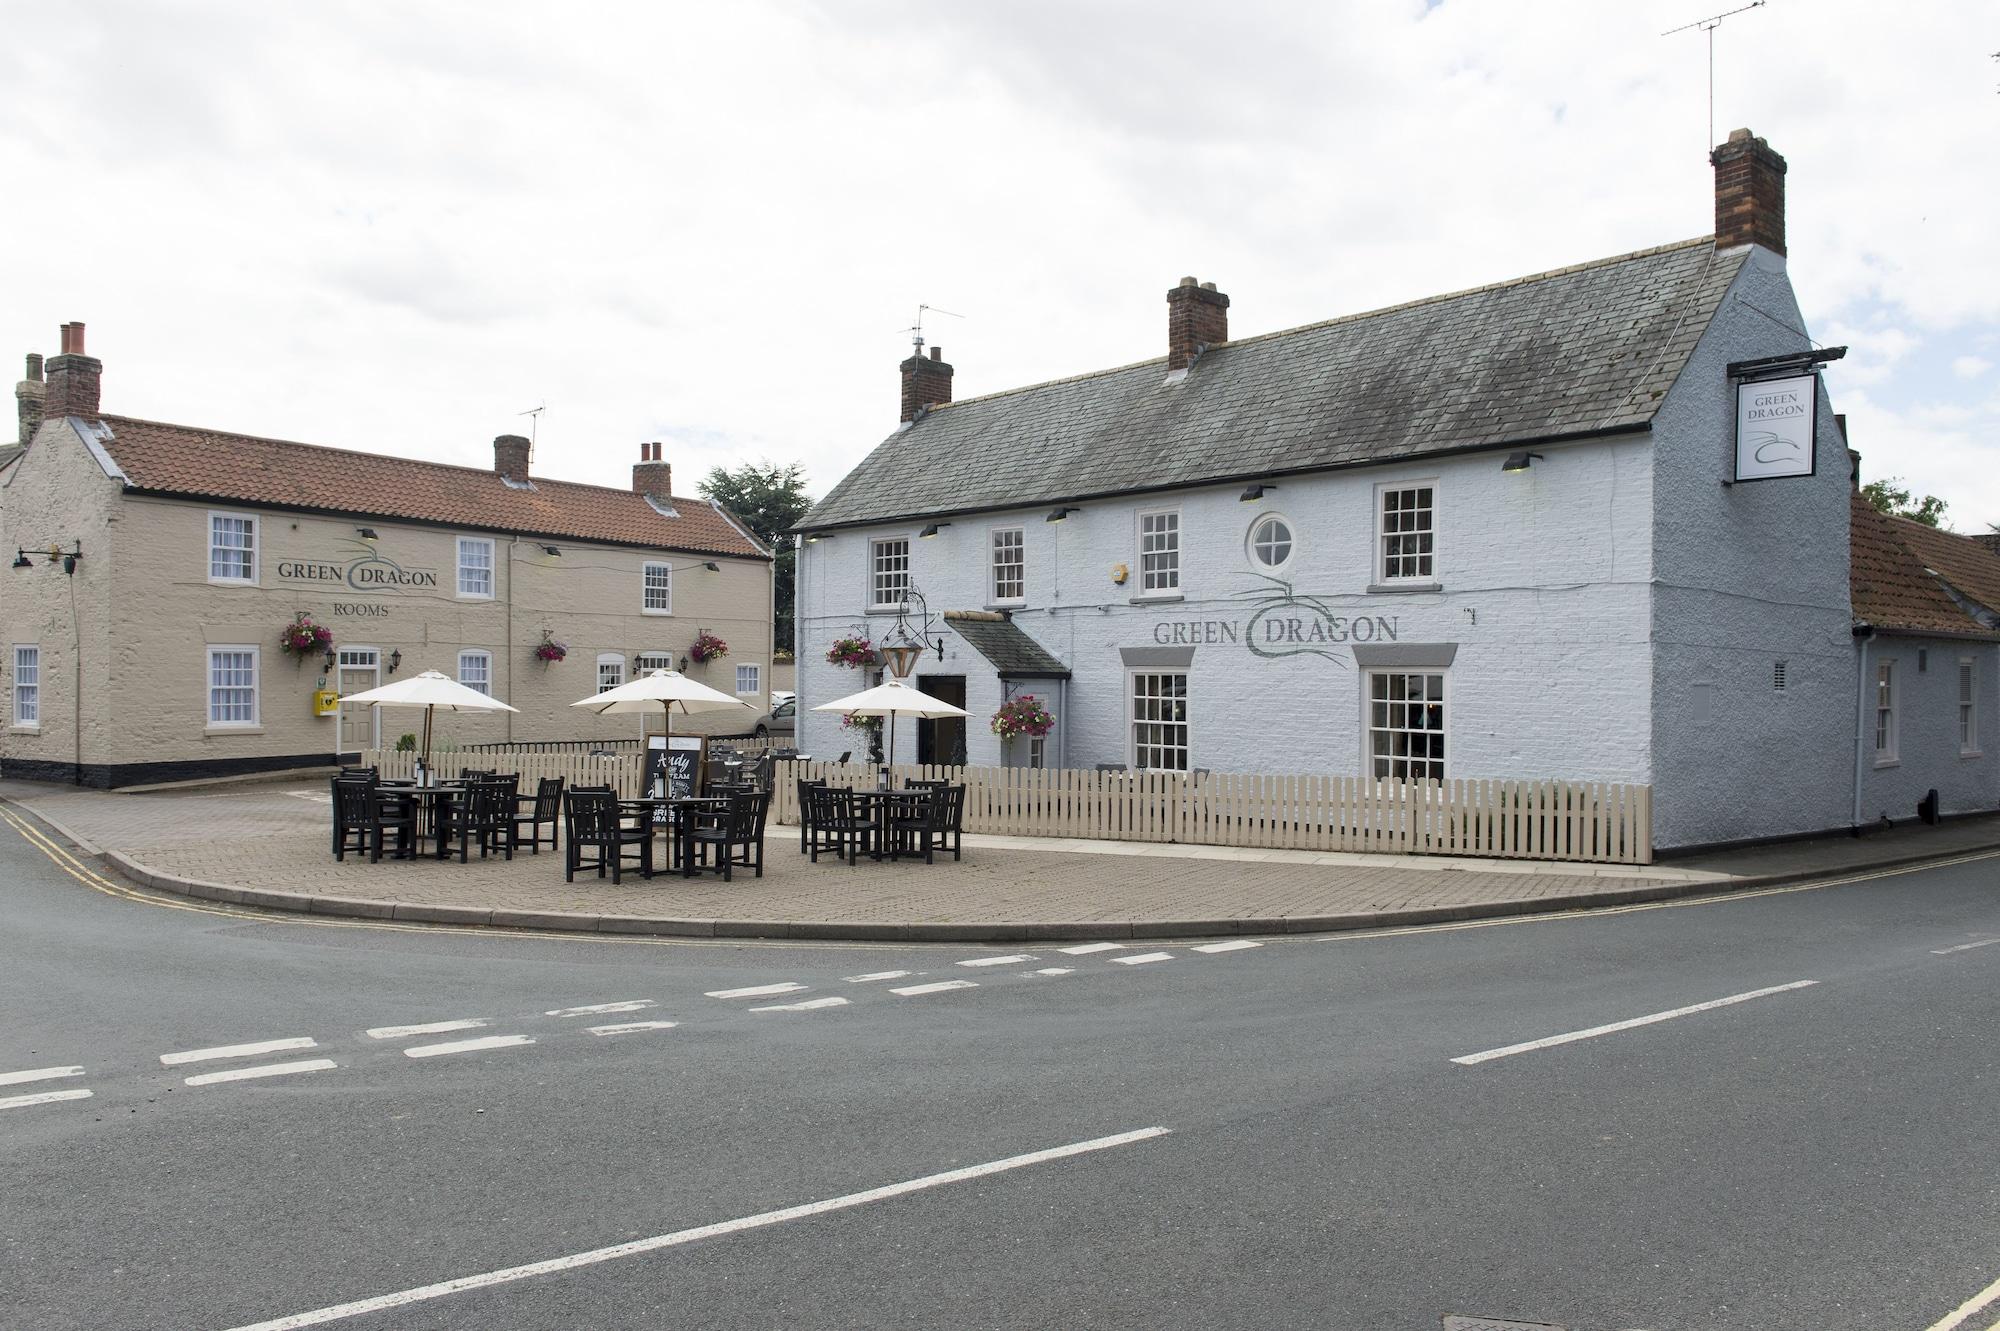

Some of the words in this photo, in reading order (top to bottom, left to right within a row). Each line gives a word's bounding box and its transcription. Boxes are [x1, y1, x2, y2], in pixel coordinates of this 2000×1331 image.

[1755, 393, 1798, 407] GREEN
[1747, 404, 1805, 420] DRAGON
[278, 562, 342, 581] GREEN
[360, 568, 437, 587] DRAGON
[333, 603, 389, 617] ROOMS
[1153, 620, 1239, 645] GREEN
[1265, 615, 1399, 643] DRAGON
[656, 752, 690, 773] Andy
